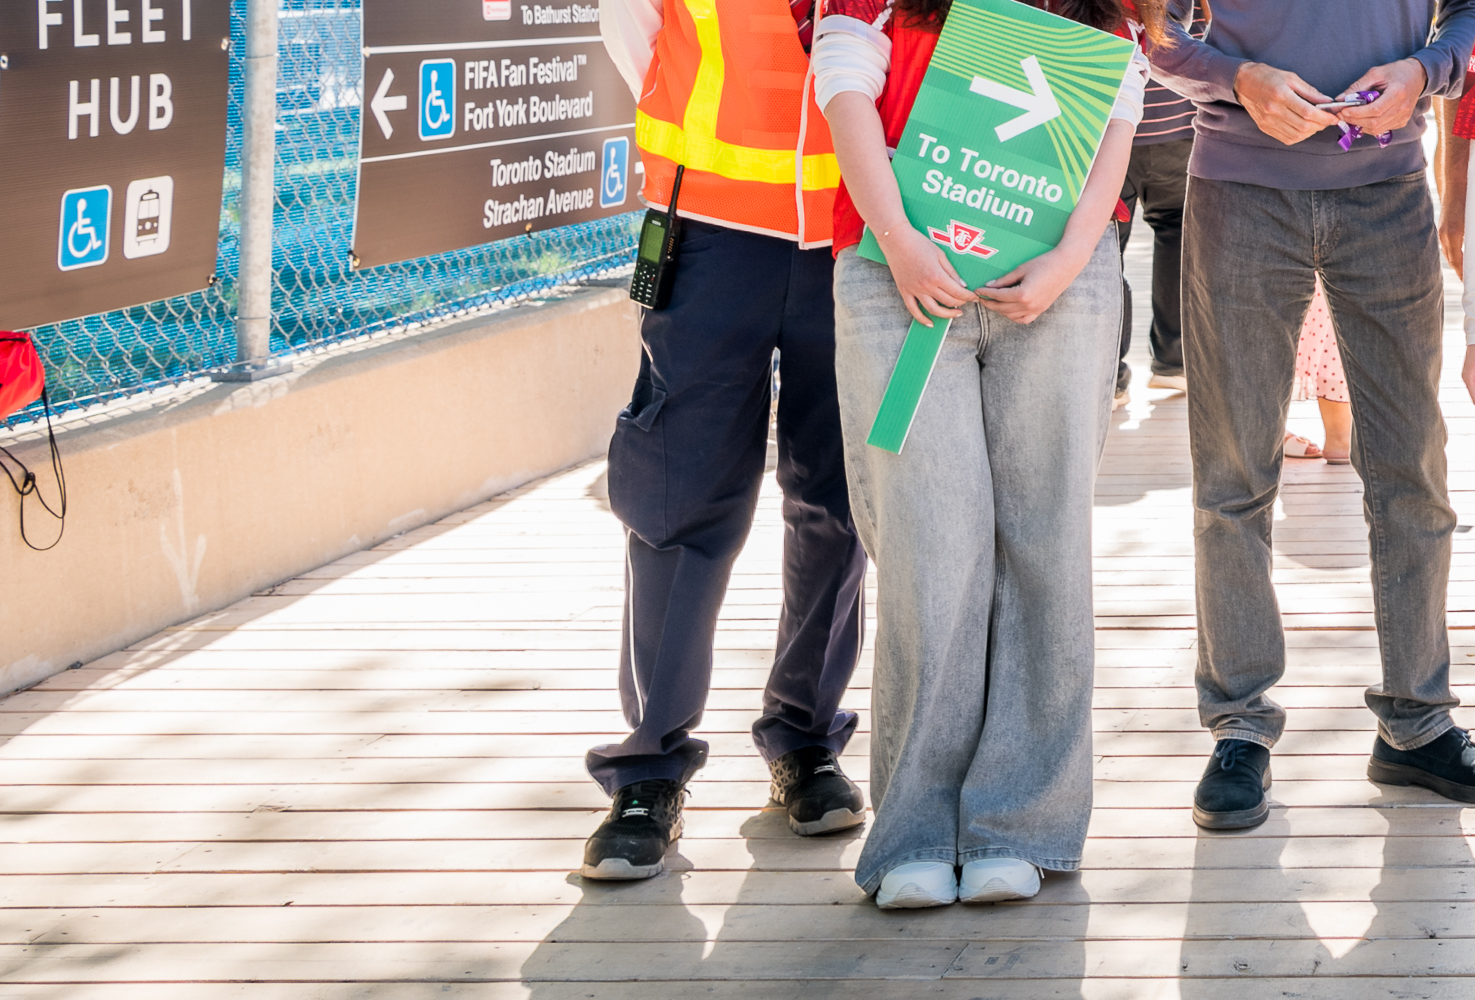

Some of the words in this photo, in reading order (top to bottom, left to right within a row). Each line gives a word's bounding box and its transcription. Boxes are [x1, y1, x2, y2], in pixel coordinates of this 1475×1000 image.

[520, 5, 533, 25] To
[534, 4, 571, 24] Bathurst
[465, 60, 498, 90] FIFA
[500, 58, 526, 87] Fan
[69, 73, 173, 139] HUB
[464, 102, 494, 131] Fort
[496, 97, 527, 128] York
[529, 90, 593, 124] Boulevard
[490, 155, 541, 187] Toronto
[544, 147, 595, 178] Stadium
[918, 132, 950, 164] To
[960, 147, 1063, 203] Toronto
[483, 194, 544, 229] Strachan
[545, 187, 594, 216] Avenue
[921, 169, 1034, 226] Stadium
